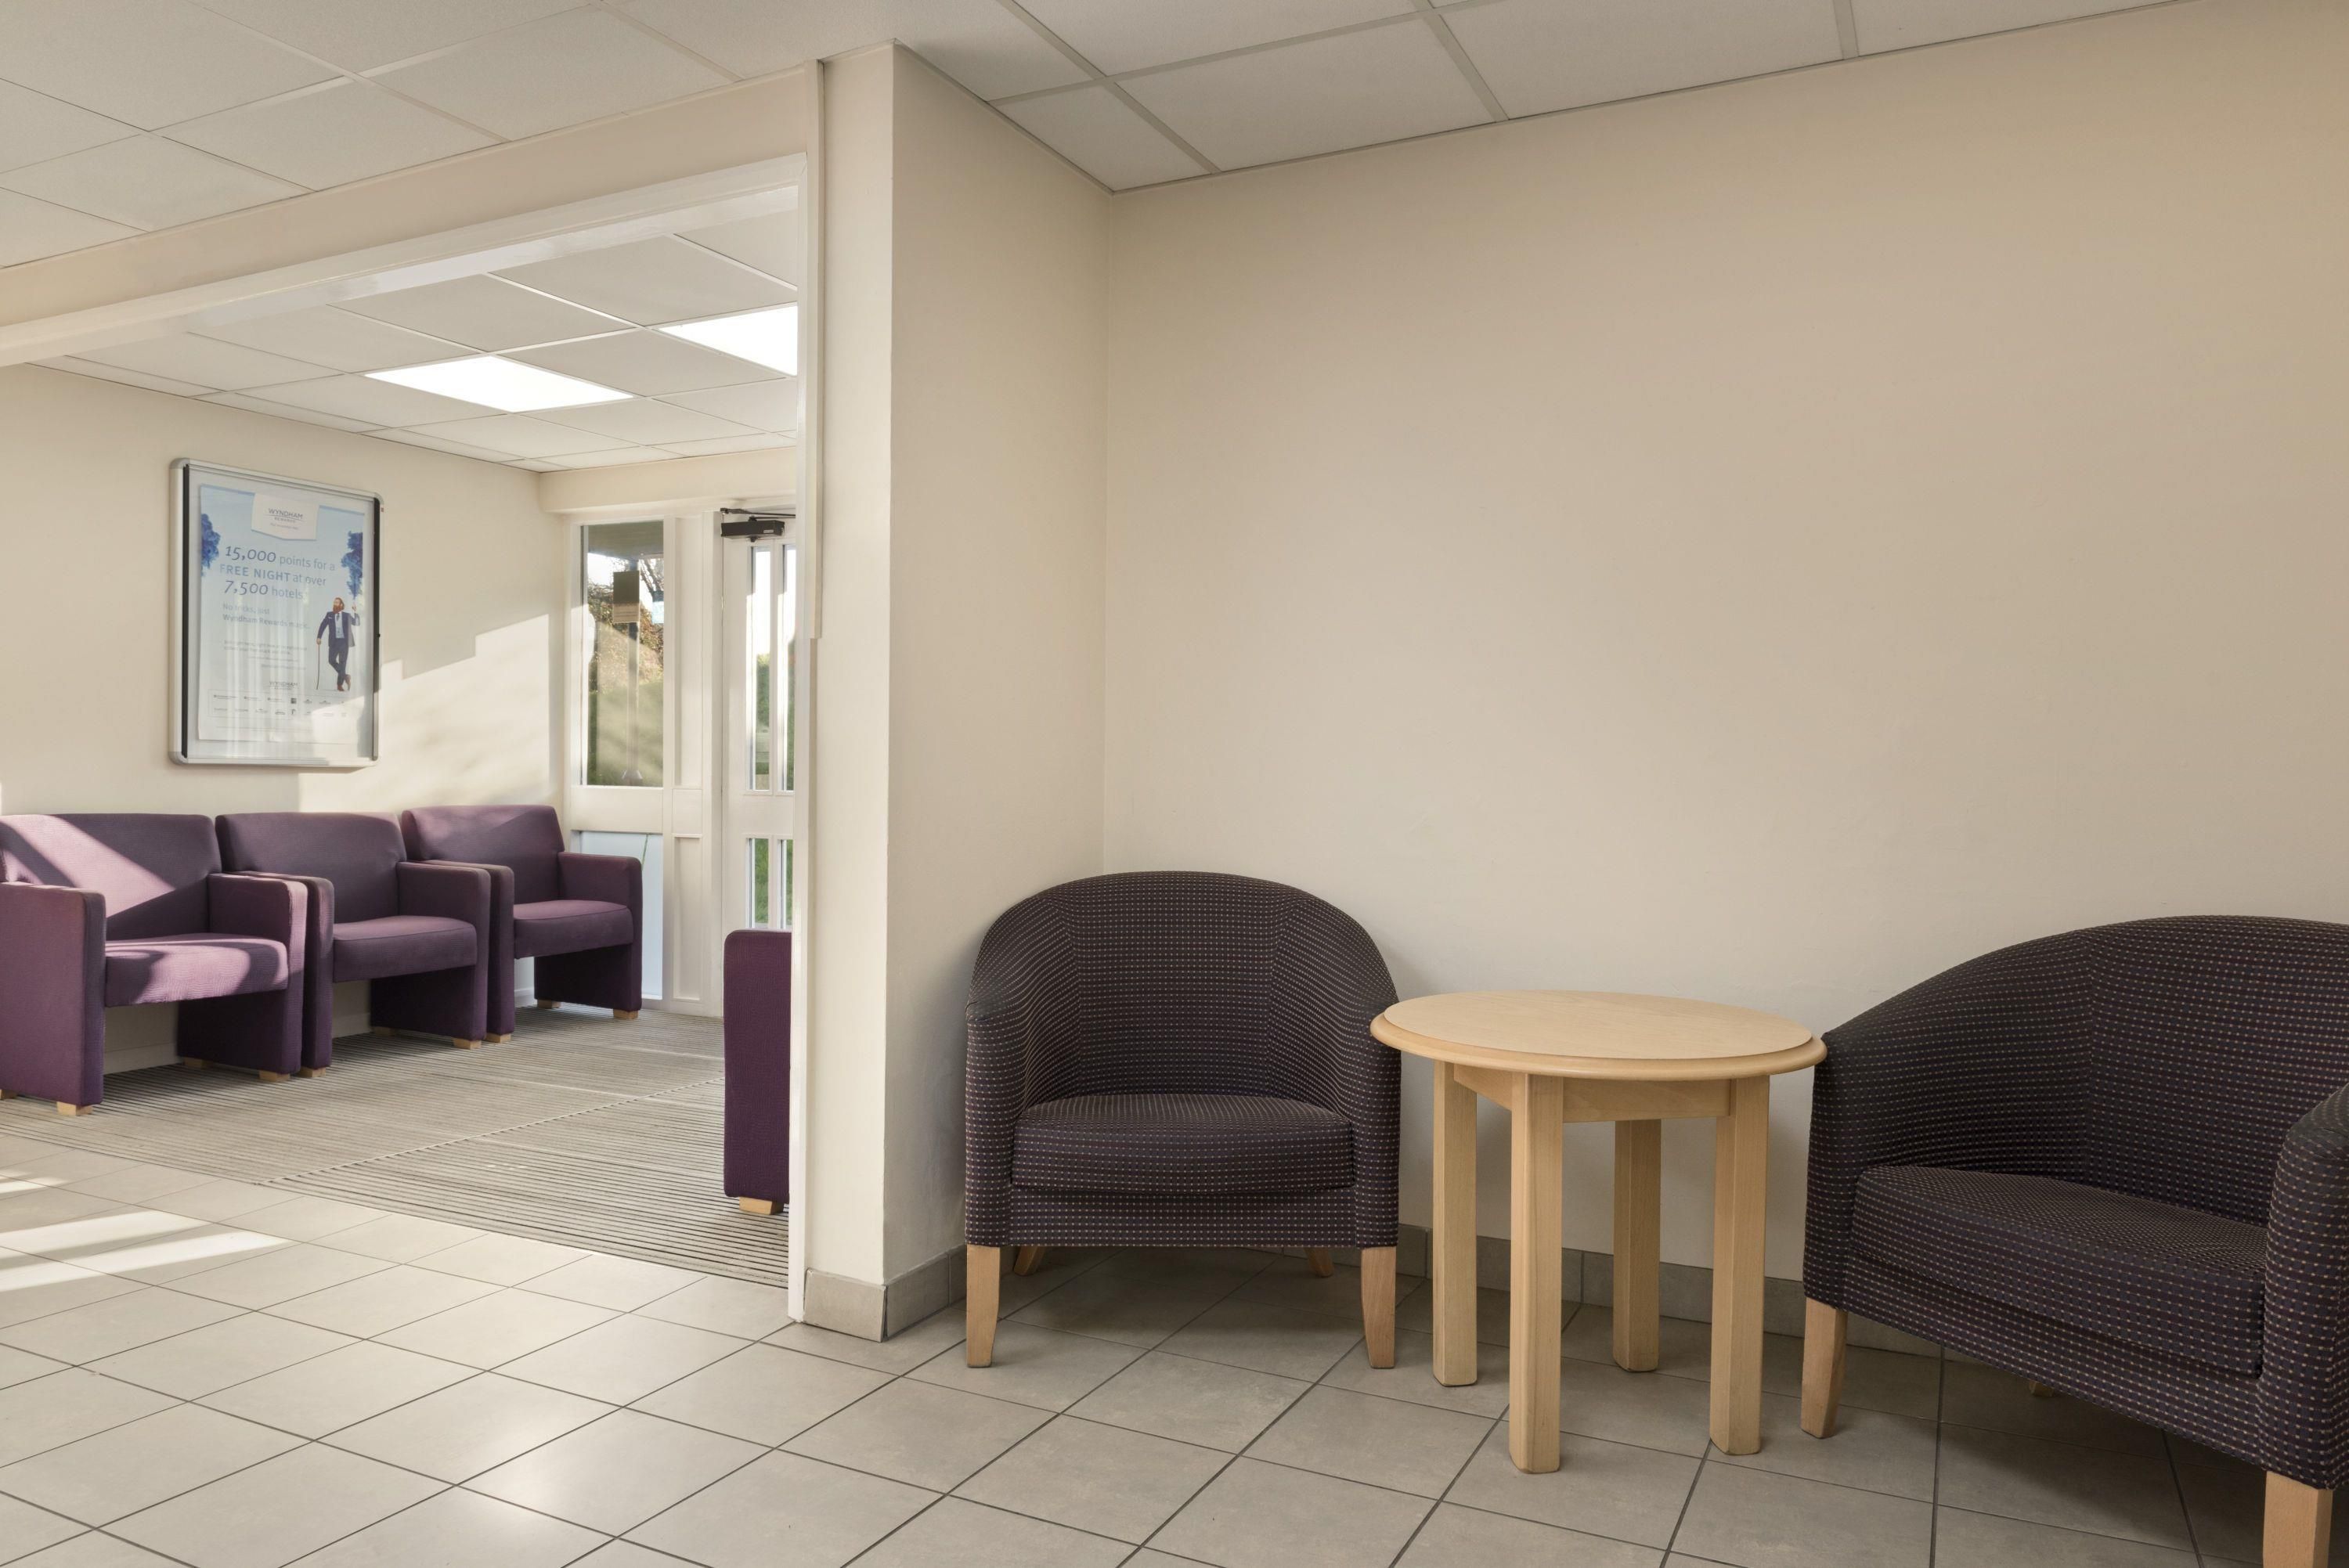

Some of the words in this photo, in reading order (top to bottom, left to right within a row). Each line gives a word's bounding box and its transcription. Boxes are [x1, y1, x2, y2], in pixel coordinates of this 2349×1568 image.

[268, 507, 303, 519] WYNDHAM
[226, 546, 276, 563] 15,000
[280, 555, 310, 568] points
[313, 557, 327, 571] for
[220, 564, 249, 577] FREE
[254, 568, 290, 582] NIGHT
[293, 573, 302, 582] at
[305, 576, 326, 586] over
[224, 580, 269, 596] 7,500
[222, 613, 257, 624] Wyndham
